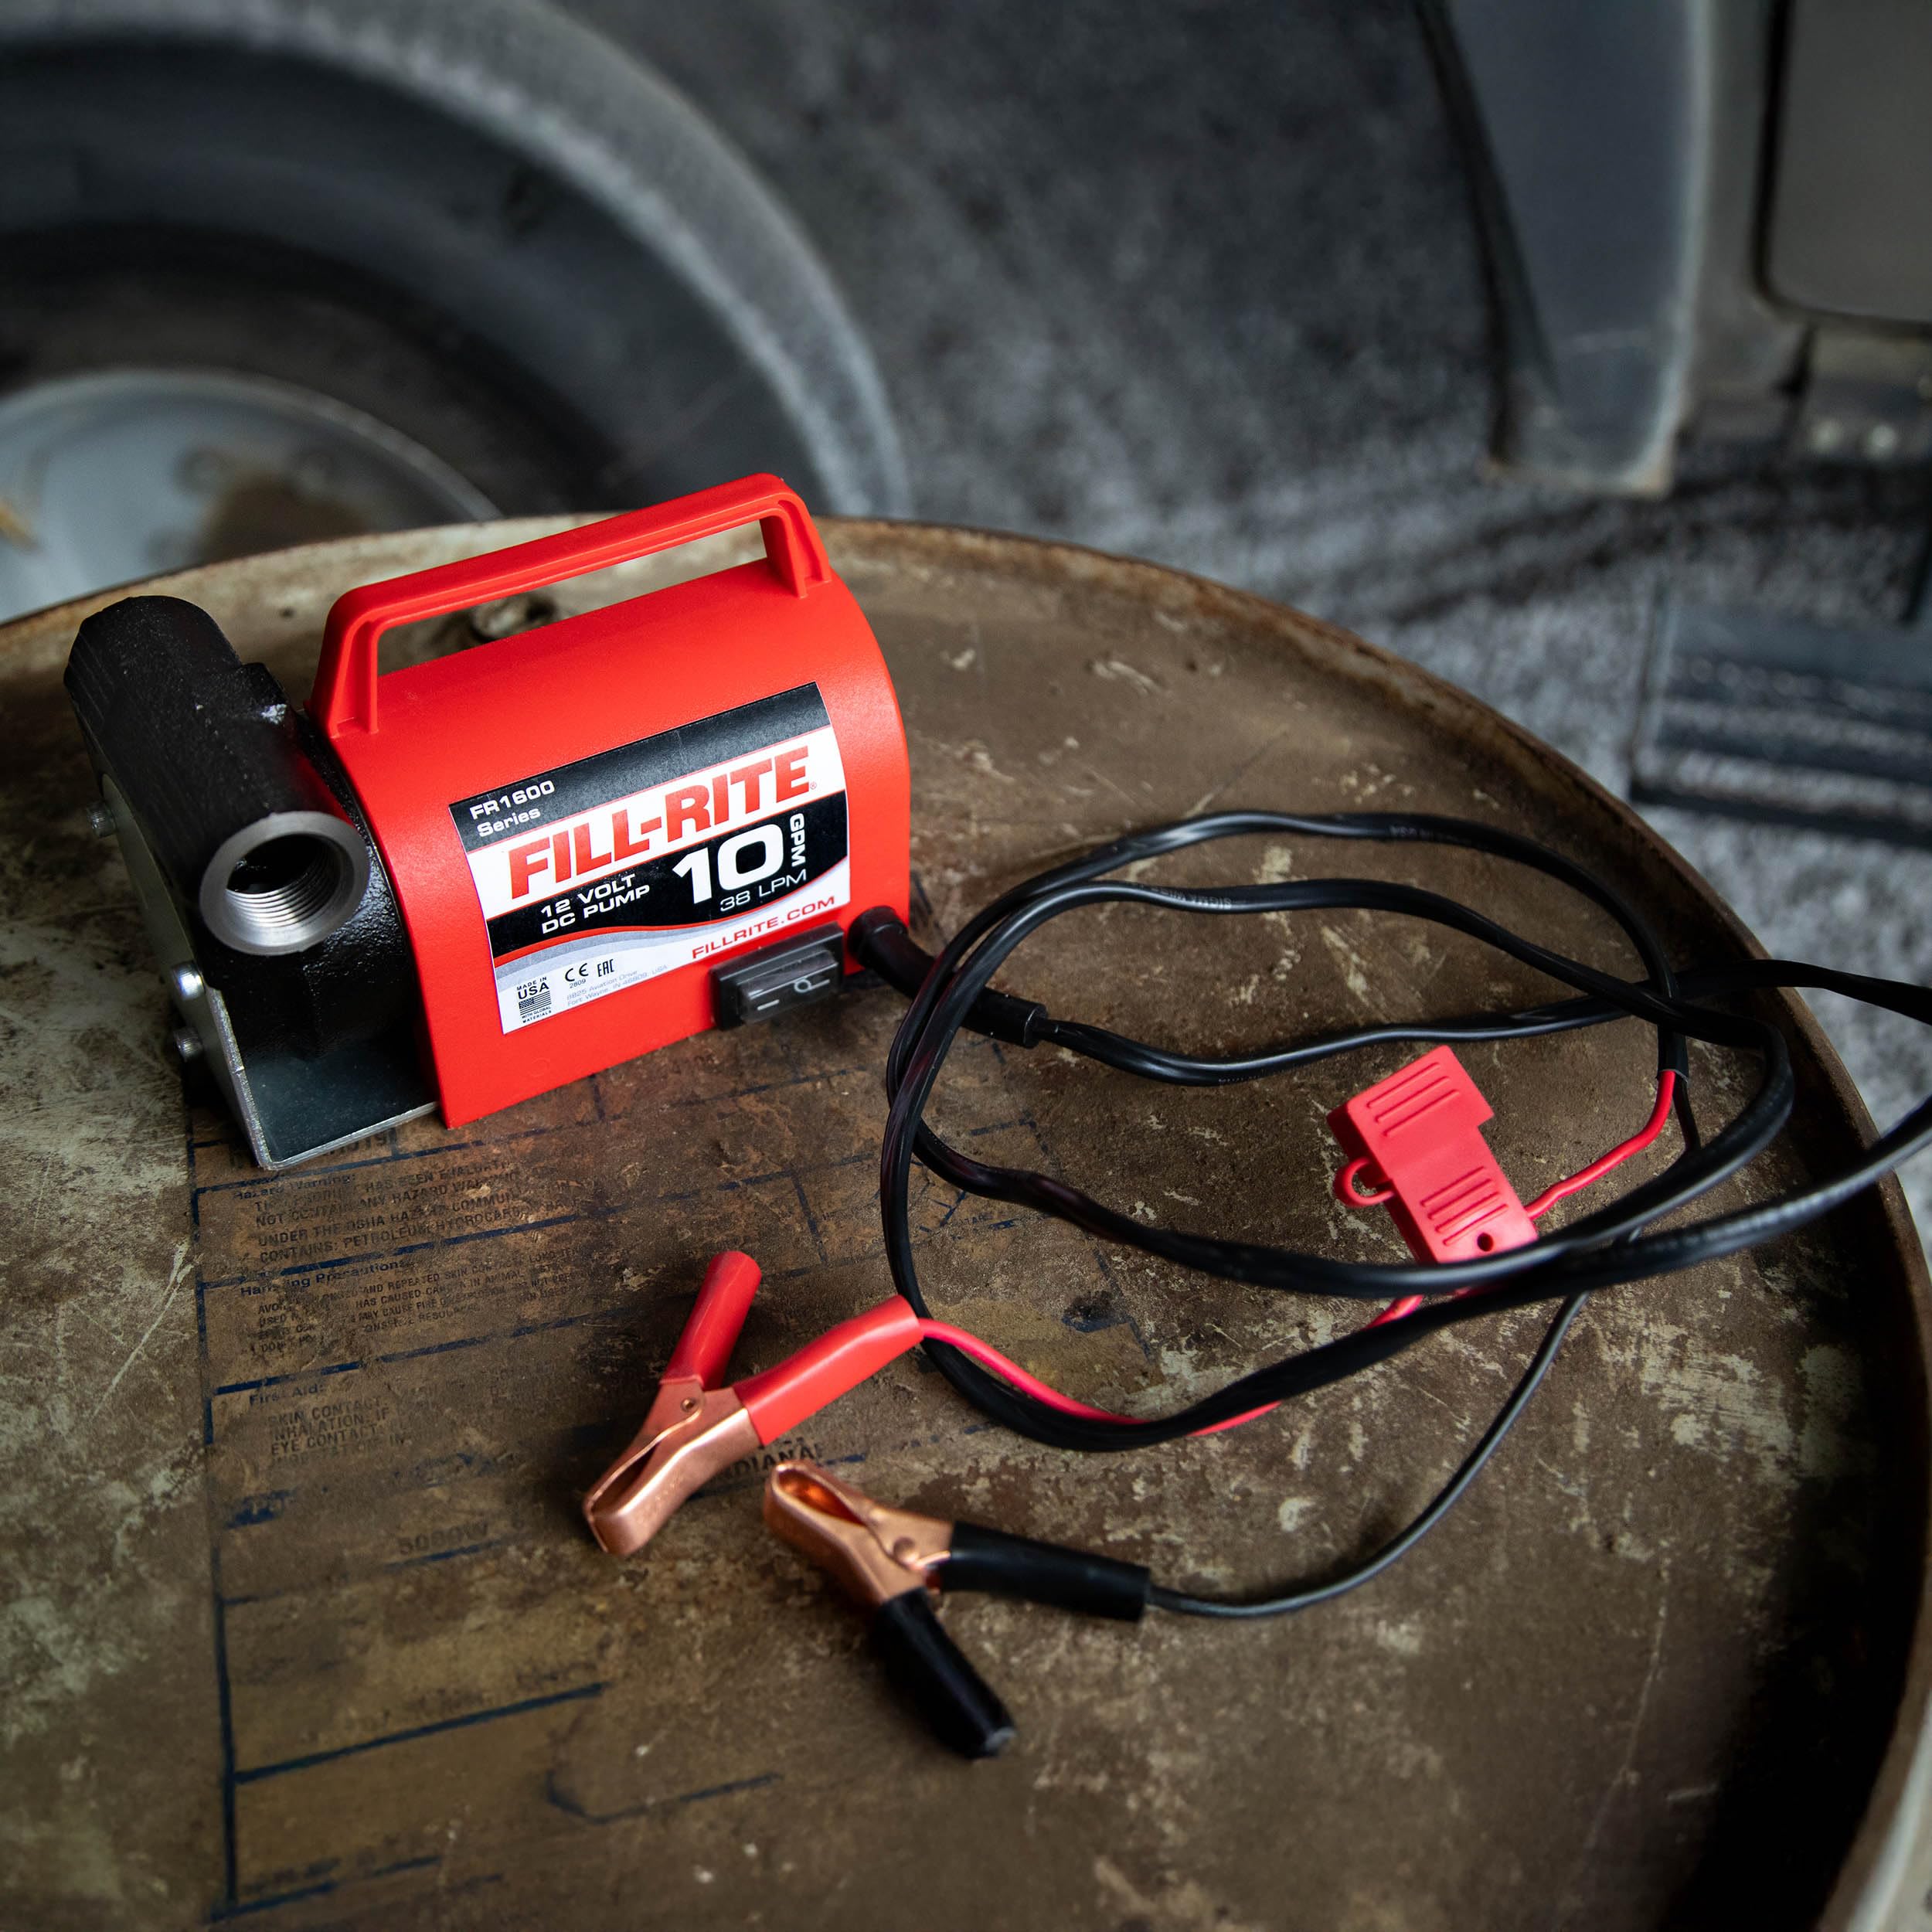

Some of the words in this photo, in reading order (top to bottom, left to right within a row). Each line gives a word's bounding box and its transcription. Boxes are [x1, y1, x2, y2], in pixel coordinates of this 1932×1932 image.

[470, 781, 555, 819] FR1600
[477, 808, 541, 837] Series
[509, 745, 809, 900] FILL-RITE
[789, 813, 806, 867] GPM
[672, 824, 784, 904] 10
[541, 899, 571, 917] 12
[578, 874, 635, 904] VOLT
[720, 891, 751, 912] 38
[759, 869, 807, 897] LPM
[542, 913, 576, 934] DC
[583, 885, 650, 919] PUMP
[692, 896, 835, 959] FILLRITE.COM
[517, 980, 537, 991] MADE
[565, 962, 589, 982] CE
[569, 978, 587, 989] 2809
[589, 977, 617, 992] Aviation
[518, 982, 549, 999] USA
[567, 997, 583, 1007] Fort
[522, 1010, 552, 1023] MATERIALS
[271, 1439, 301, 1457] EYE
